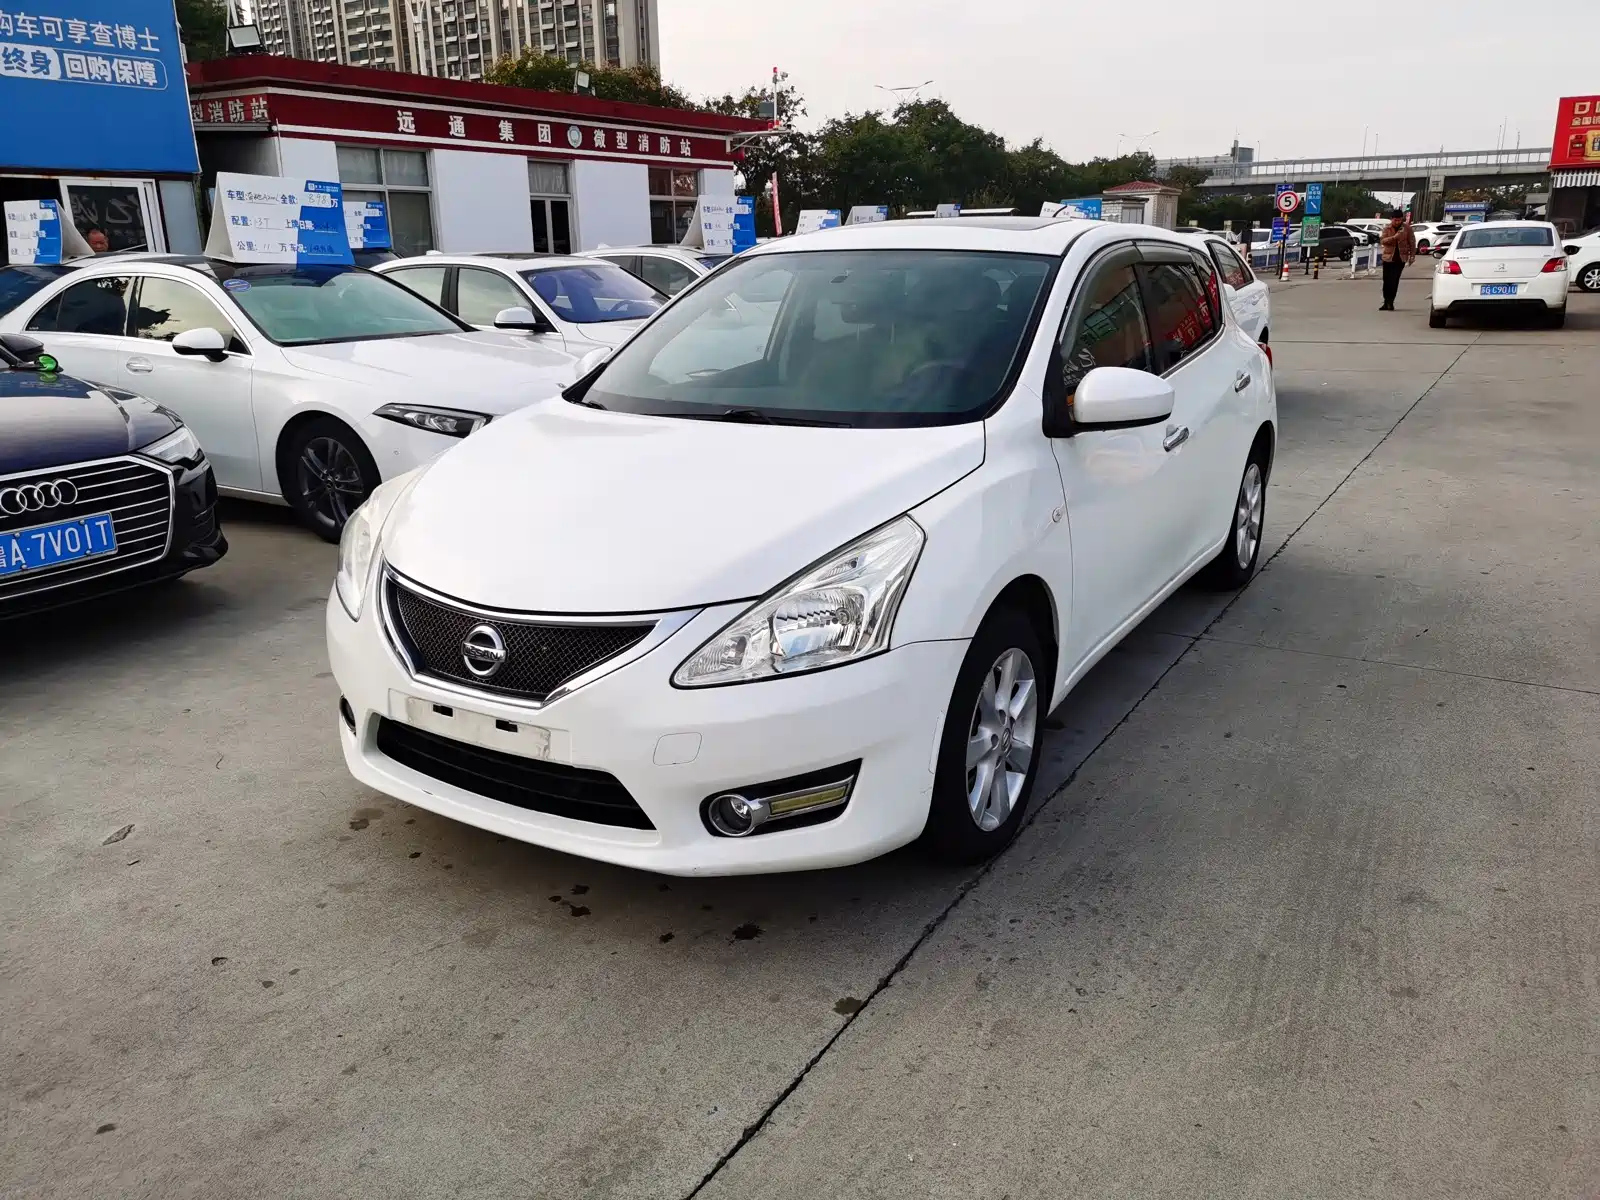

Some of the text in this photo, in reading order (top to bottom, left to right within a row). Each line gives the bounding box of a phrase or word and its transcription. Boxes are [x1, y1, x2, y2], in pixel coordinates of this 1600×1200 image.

[1, 47, 157, 86] 终身 回购保障
[397, 110, 691, 156] 远通集团 微型消防站
[1284, 196, 1292, 207] 5
